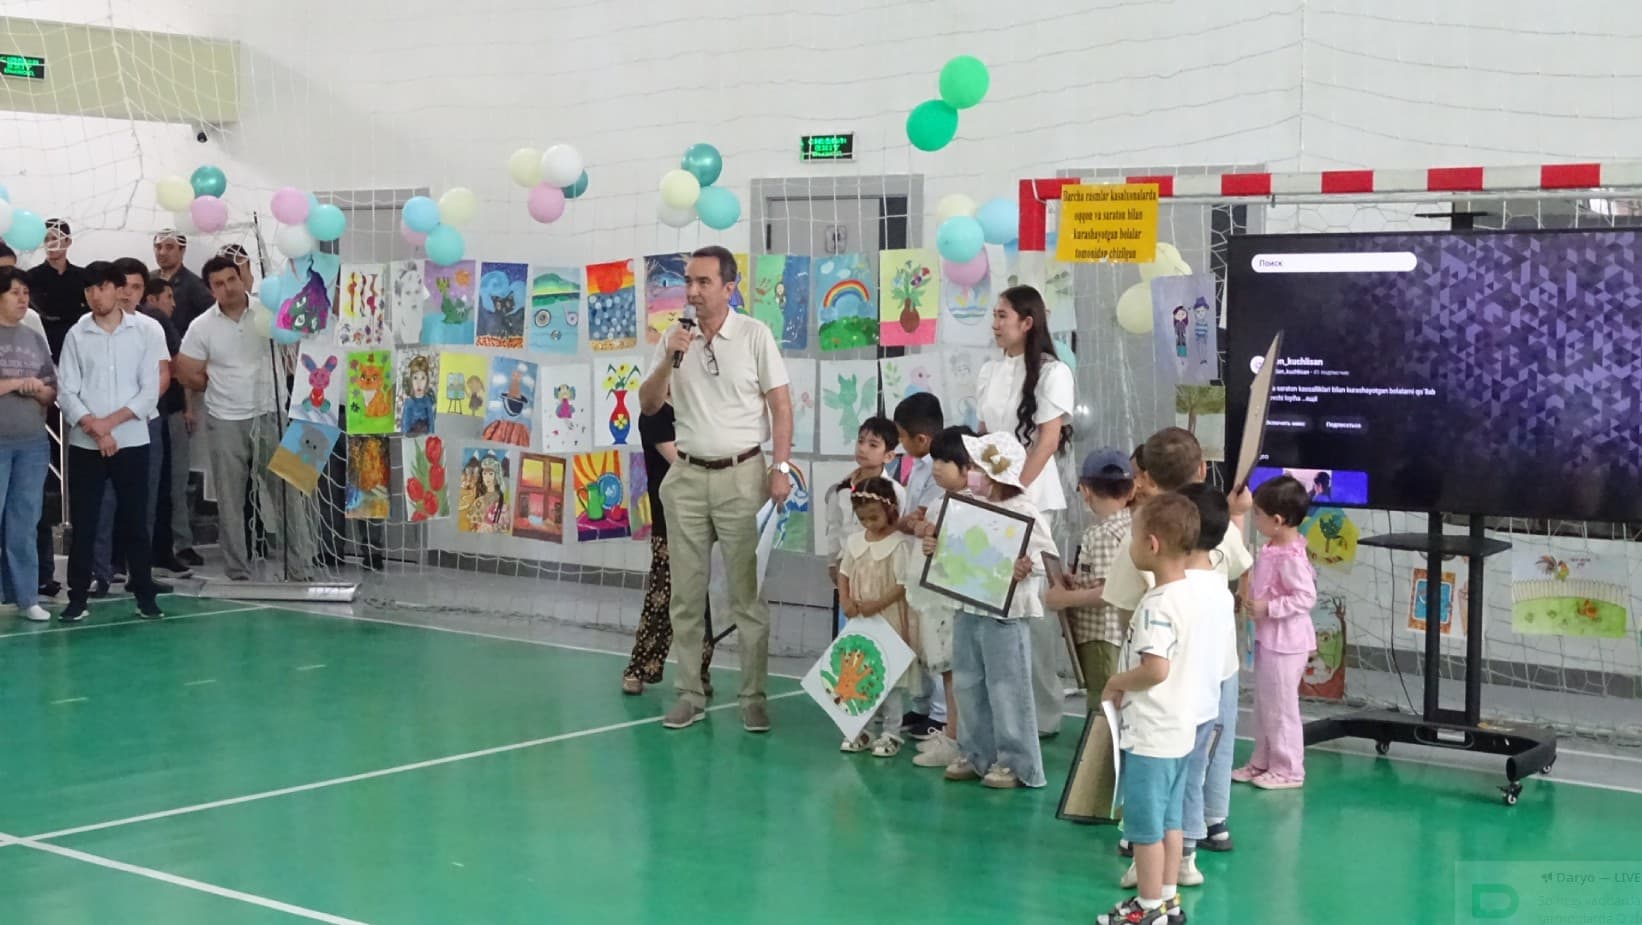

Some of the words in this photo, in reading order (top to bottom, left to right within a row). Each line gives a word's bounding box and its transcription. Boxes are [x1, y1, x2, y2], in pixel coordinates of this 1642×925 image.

[1085, 189, 1109, 201] rasmlar
[1094, 212, 1102, 220] va
[1103, 210, 1126, 220] saraton
[1127, 208, 1143, 220] bilan
[1073, 227, 1118, 243] kurashayotgan
[1119, 227, 1142, 240] bolalar
[1259, 259, 1282, 268] Поиск
